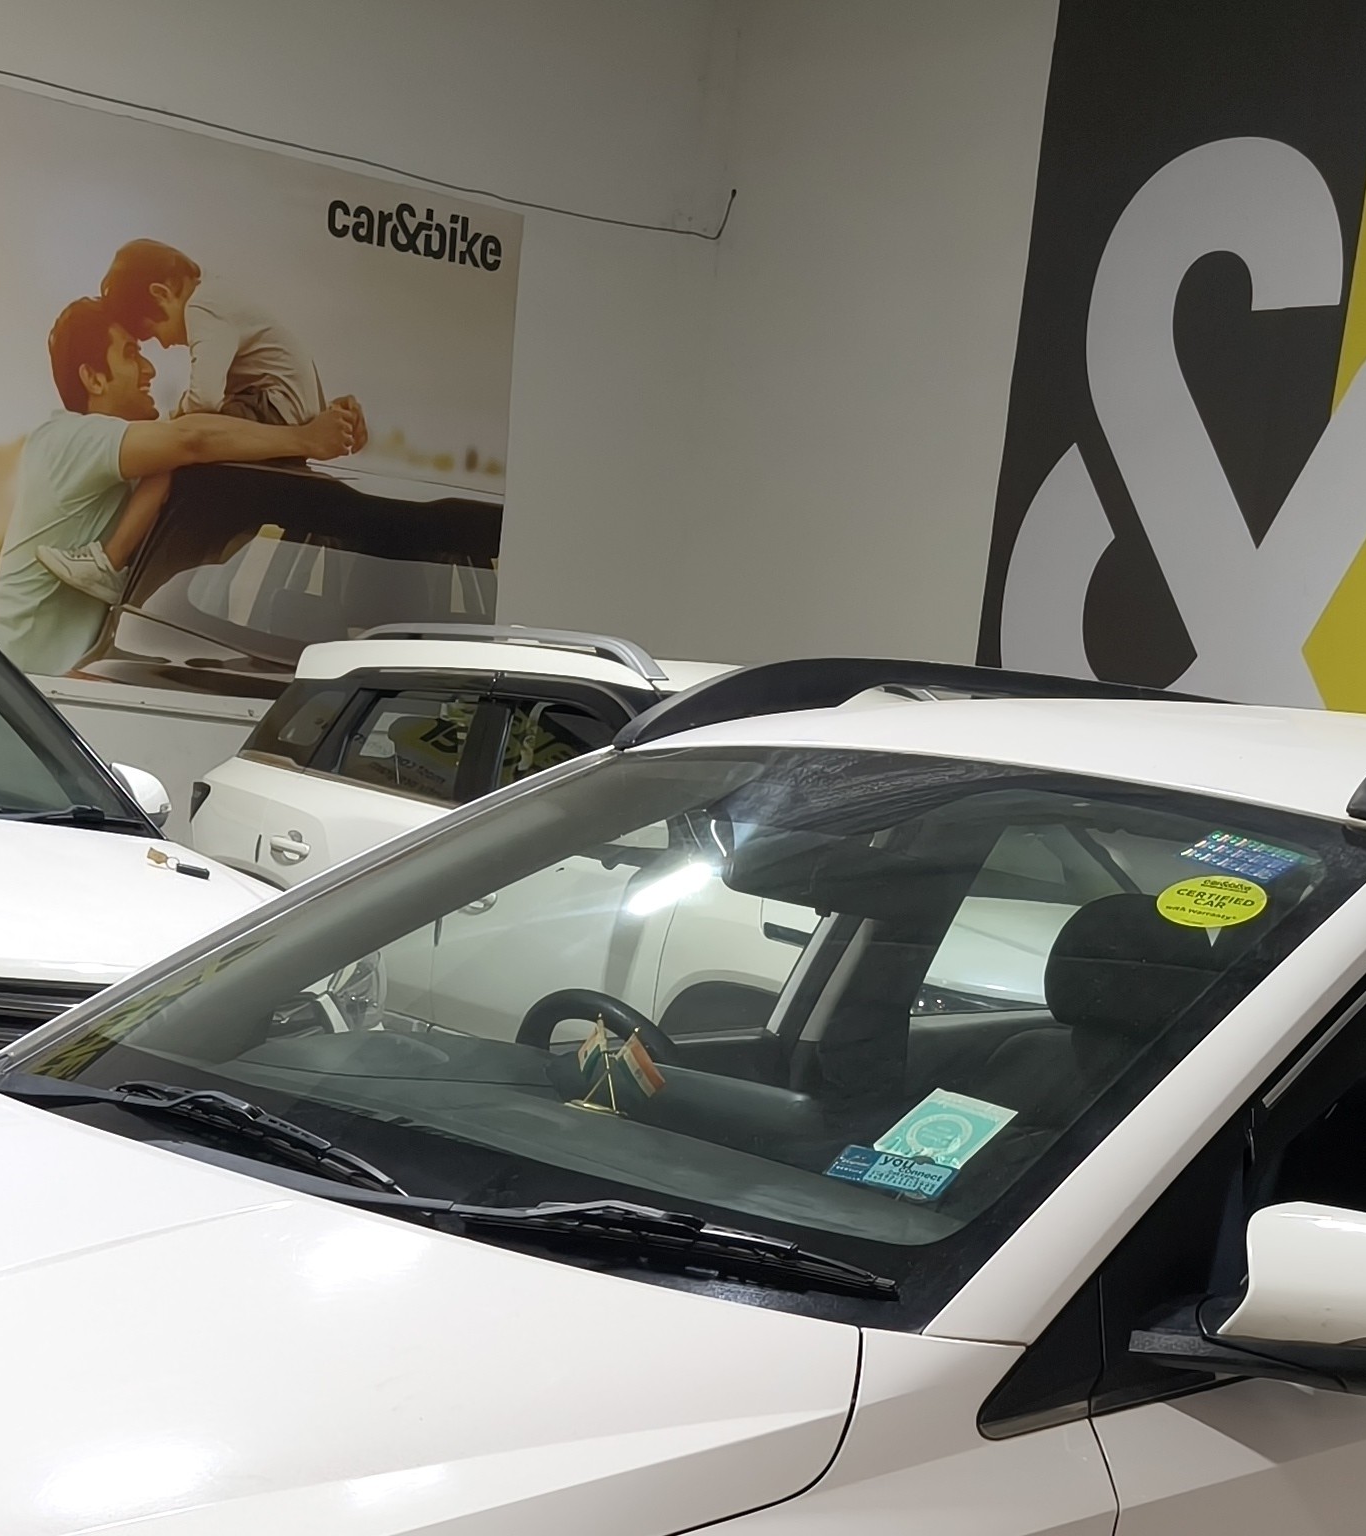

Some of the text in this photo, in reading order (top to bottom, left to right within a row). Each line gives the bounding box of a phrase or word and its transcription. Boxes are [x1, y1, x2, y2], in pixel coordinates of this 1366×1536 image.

[327, 200, 502, 271] car&bike
[1176, 888, 1256, 907] CERTIFIED
[1193, 898, 1227, 909] CAR
[899, 1166, 943, 1182] connect
